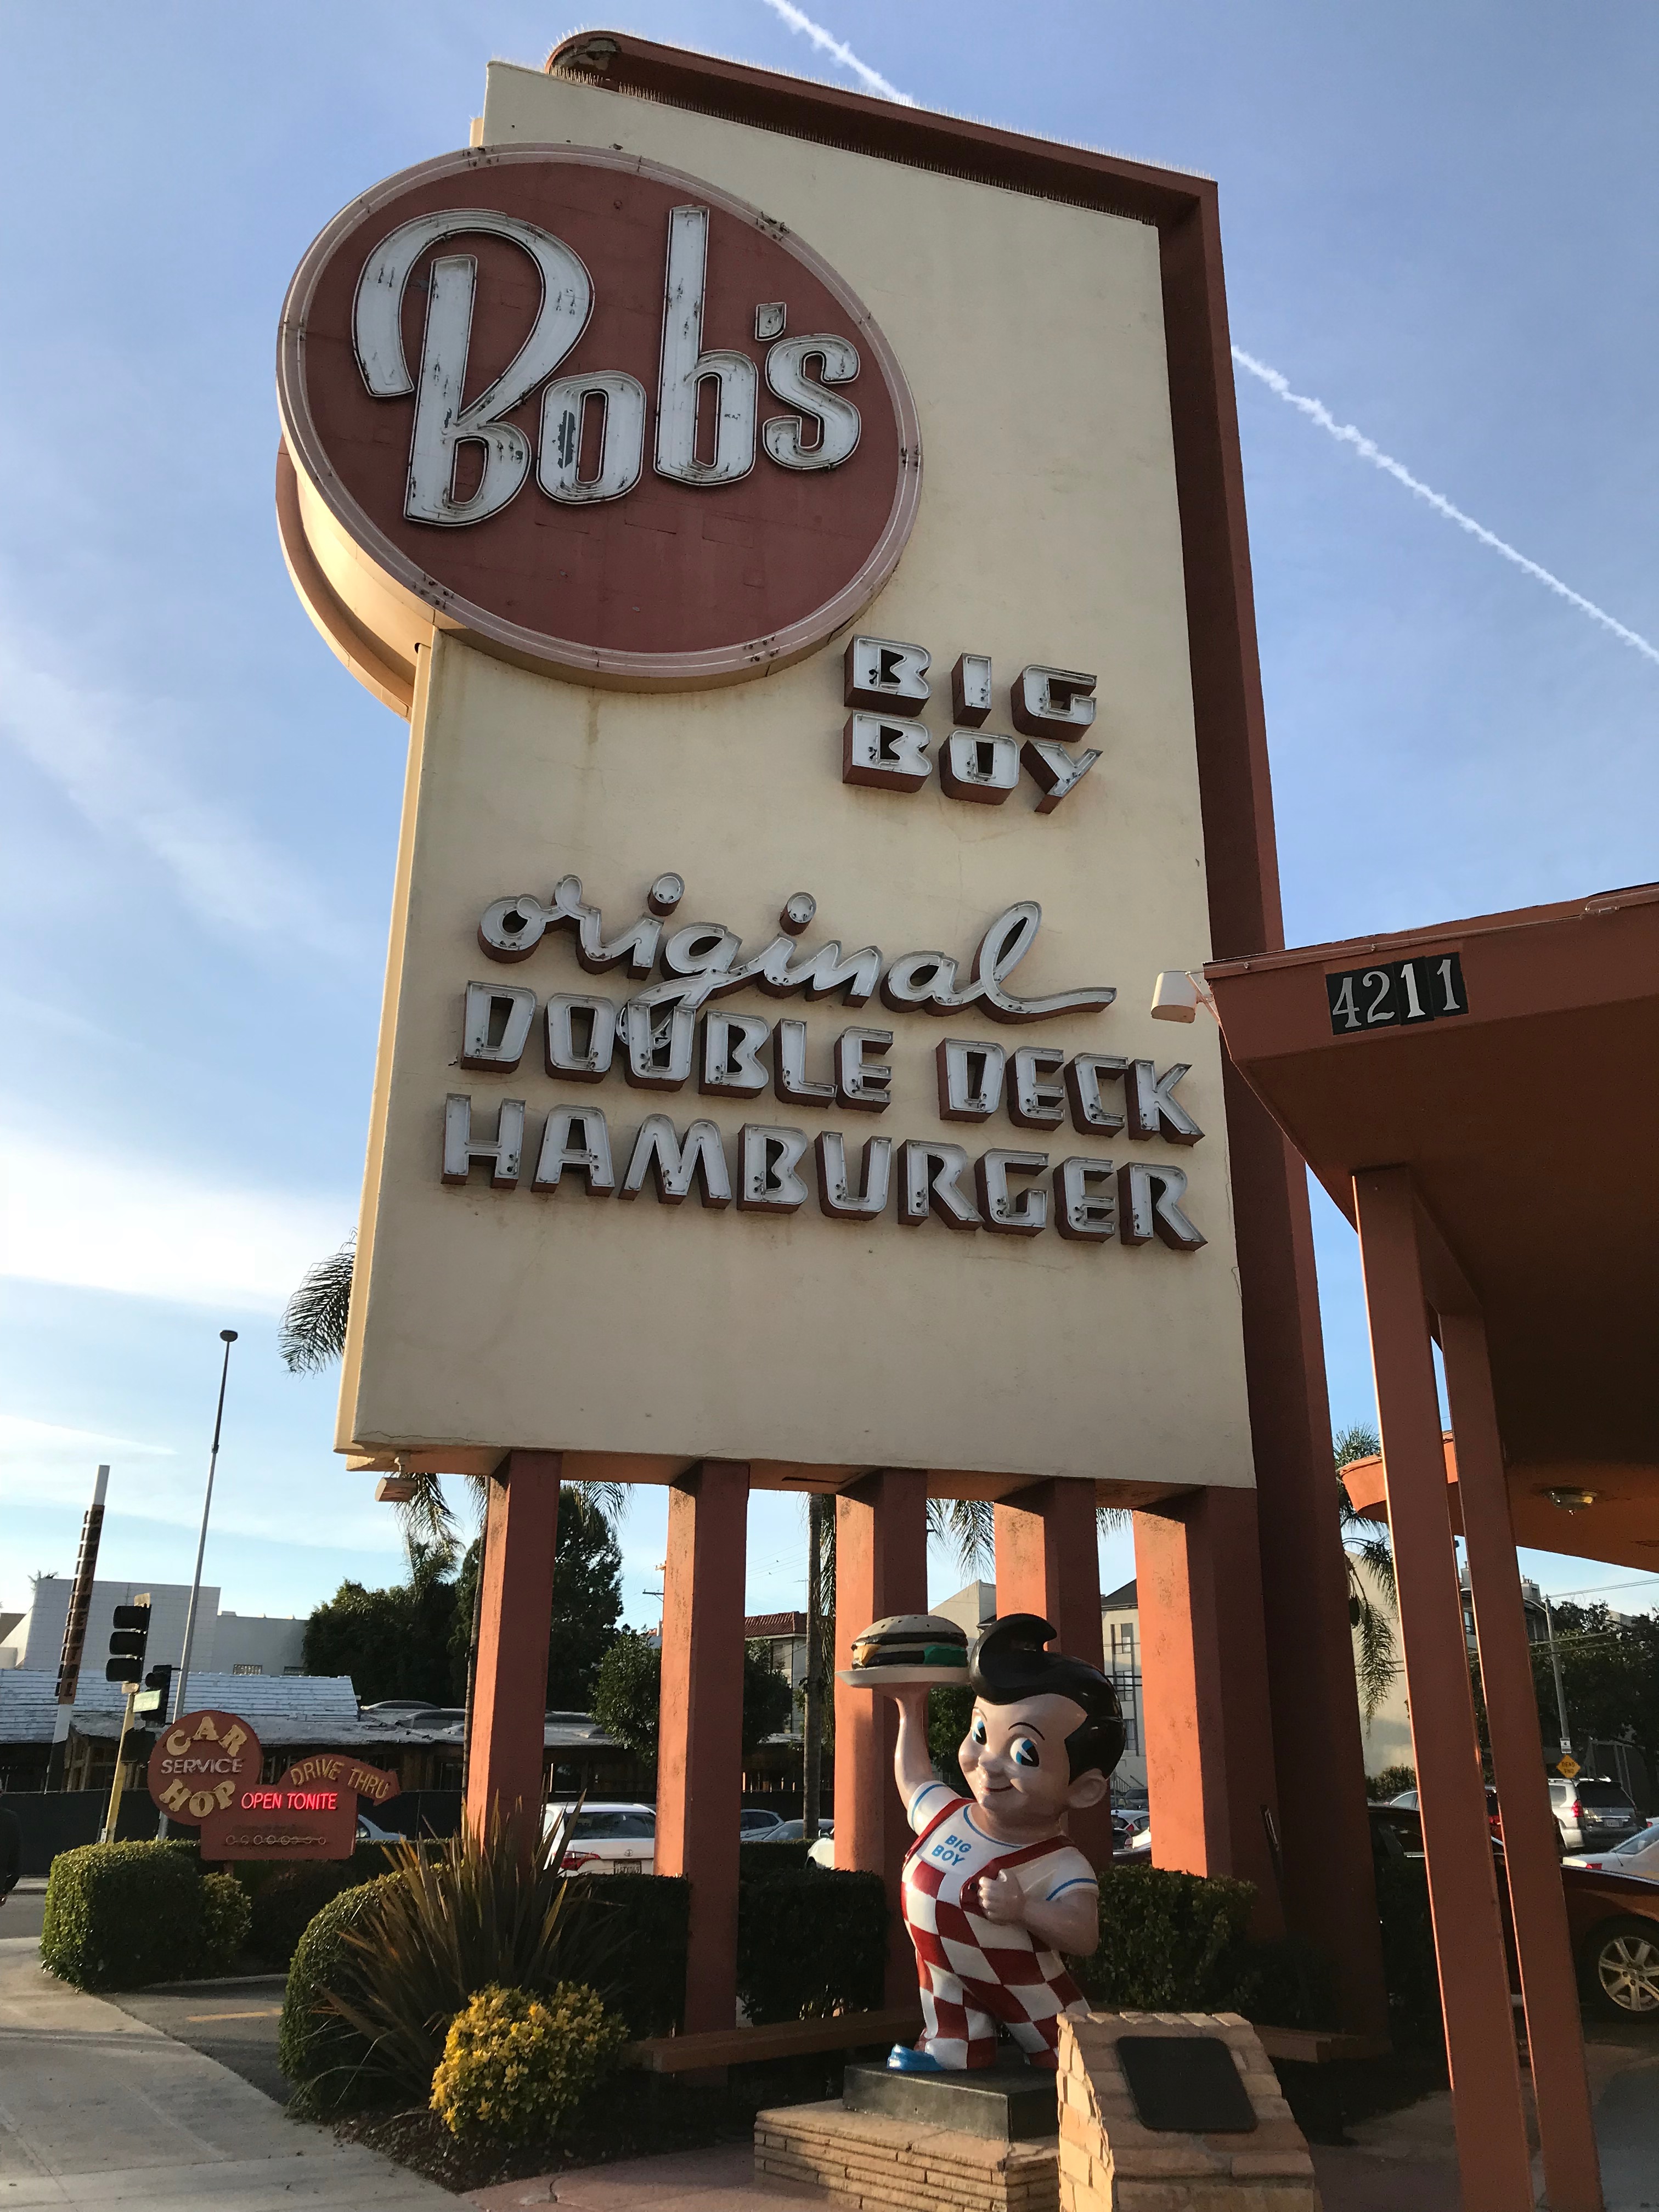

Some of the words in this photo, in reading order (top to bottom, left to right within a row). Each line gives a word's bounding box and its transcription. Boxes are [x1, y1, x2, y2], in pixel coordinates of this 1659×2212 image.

[352, 205, 861, 527] Bob's
[844, 634, 1097, 741] BIG
[843, 710, 1104, 813] BOY
[478, 872, 1117, 1048] original
[1333, 959, 1460, 1028] 4211
[461, 981, 894, 1113] DOUBLE
[937, 1038, 1205, 1144] DECK
[441, 1093, 1207, 1251] HAMBURGER
[166, 1716, 247, 1757] CAR
[161, 1758, 243, 1774] SERVICE
[290, 1758, 345, 1786] DRIVE
[347, 1768, 390, 1799] THRU
[159, 1779, 236, 1818] HOP
[241, 1792, 283, 1809] OPEN
[286, 1792, 338, 1810] TONITE
[932, 1844, 966, 1866] BOY
[944, 1834, 972, 1853] BIG
